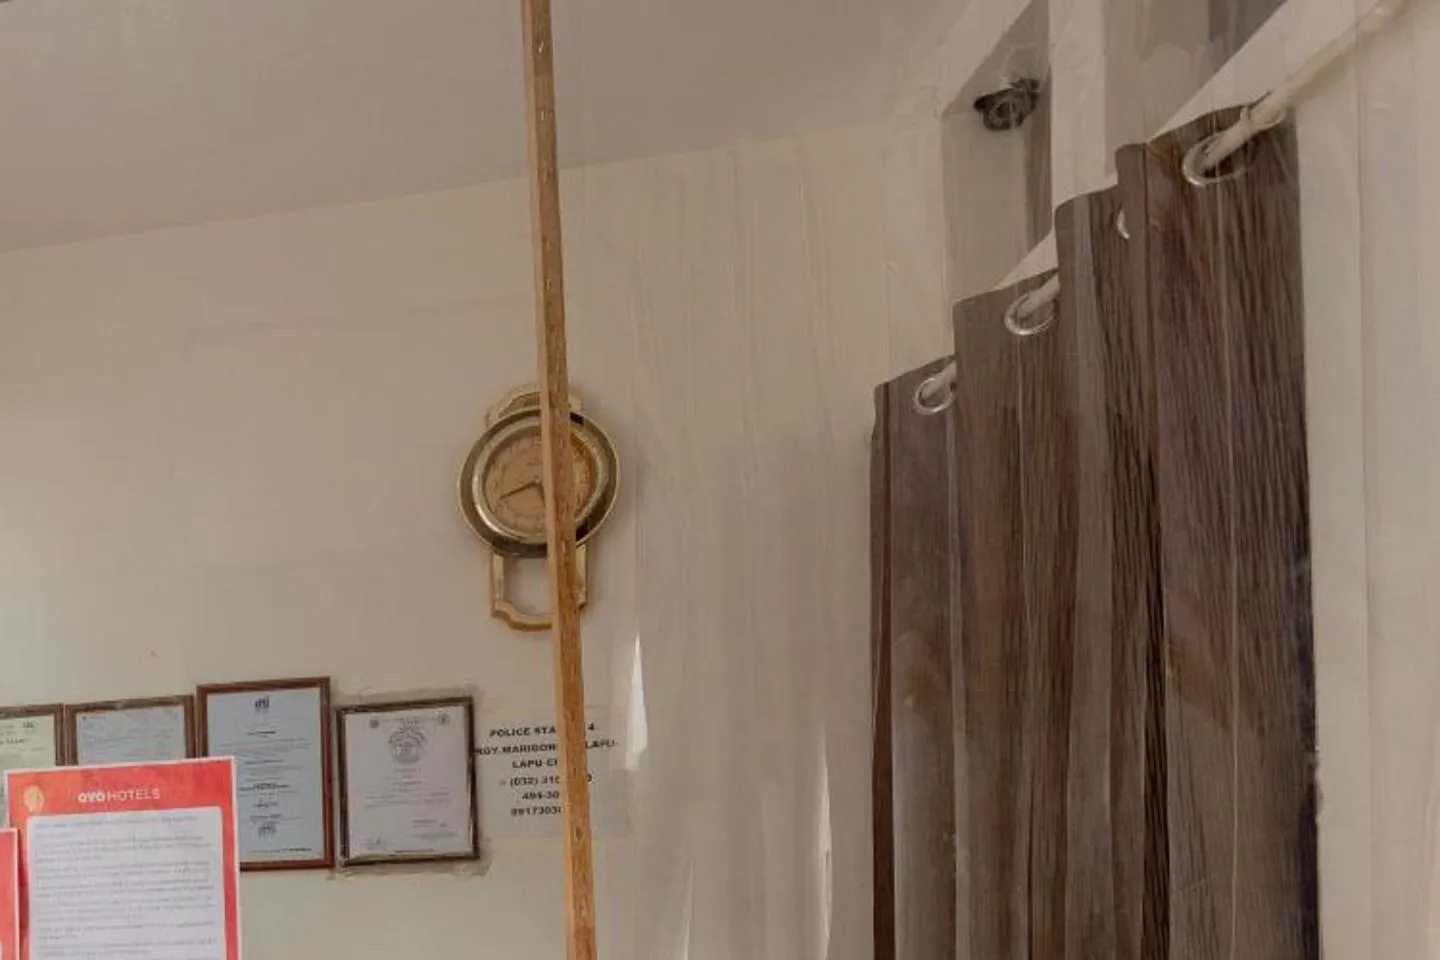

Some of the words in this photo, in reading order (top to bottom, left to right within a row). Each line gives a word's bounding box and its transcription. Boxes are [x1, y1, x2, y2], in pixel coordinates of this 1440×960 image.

[489, 727, 531, 738] POLICE
[588, 722, 595, 731] 4
[512, 758, 543, 769] LAPU
[106, 787, 161, 802] HOTELS
